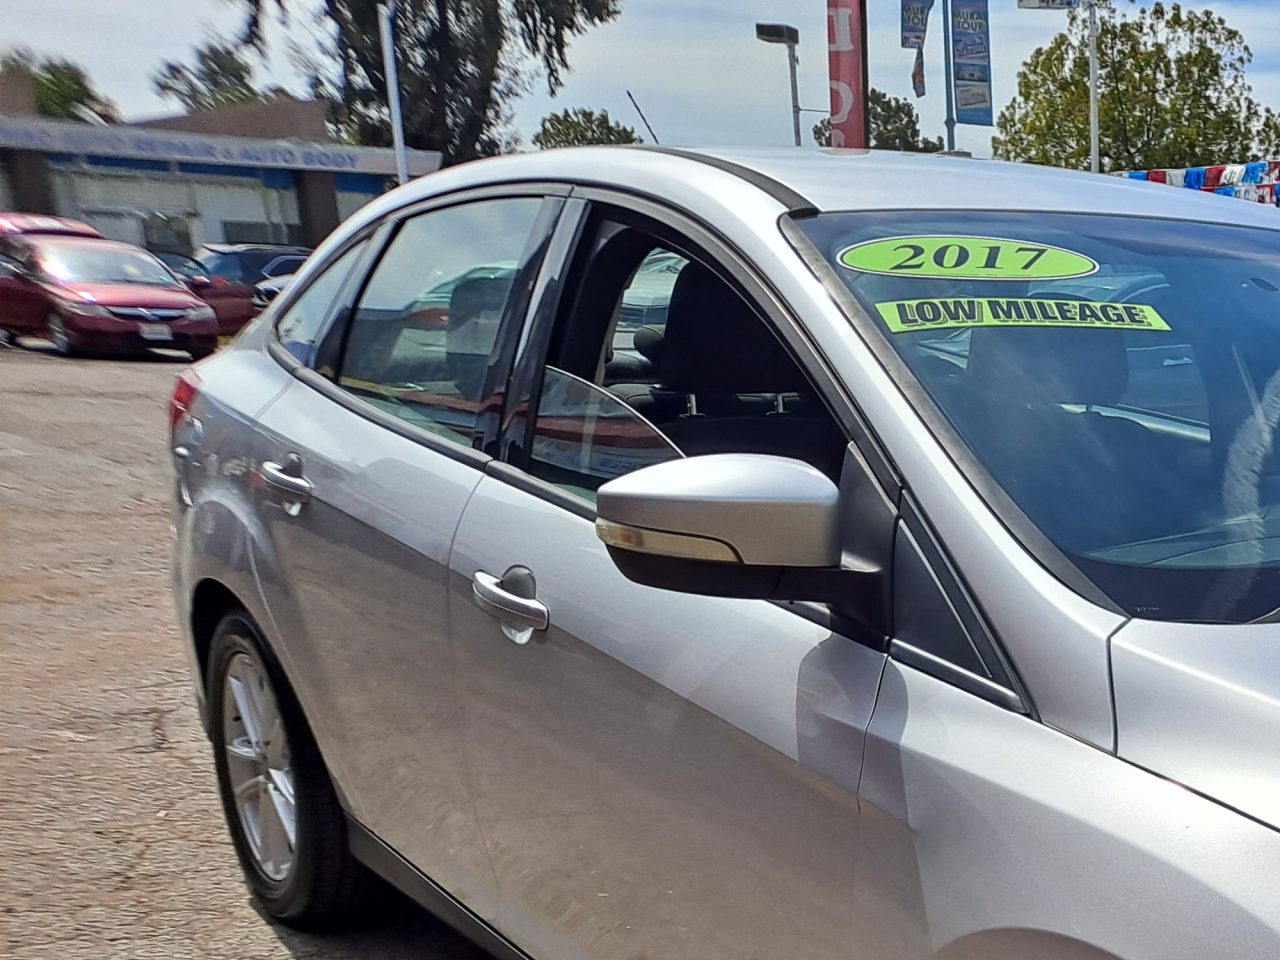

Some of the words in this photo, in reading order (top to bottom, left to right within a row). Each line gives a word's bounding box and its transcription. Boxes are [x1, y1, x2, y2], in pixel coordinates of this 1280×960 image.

[889, 244, 1048, 271] 2017
[896, 300, 980, 327] LOW
[987, 300, 1149, 327] MILEAGE
